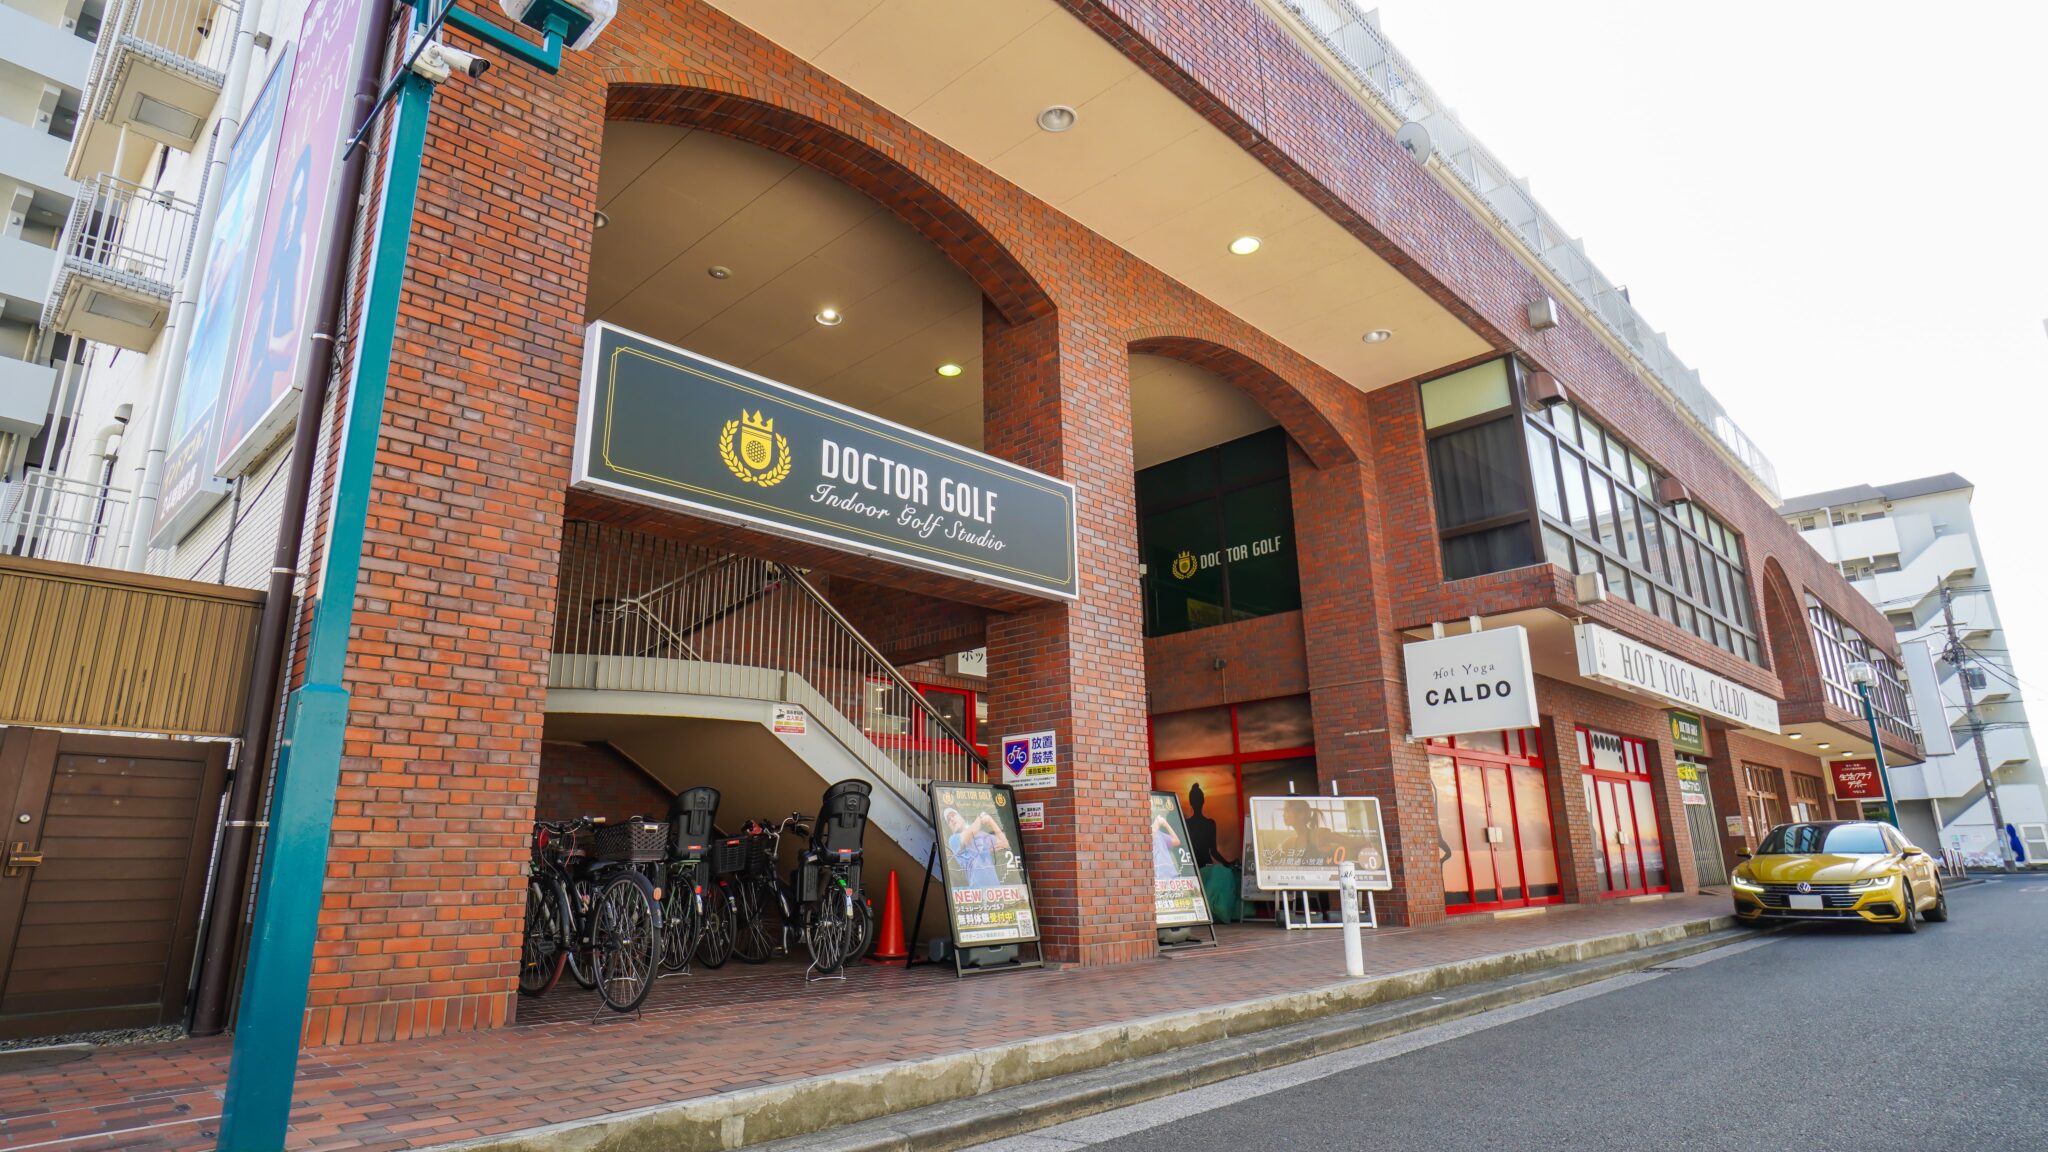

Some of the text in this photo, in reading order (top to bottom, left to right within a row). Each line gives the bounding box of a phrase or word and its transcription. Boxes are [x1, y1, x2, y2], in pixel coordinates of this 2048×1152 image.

[821, 439, 998, 524] DOCTOR GOLF
[810, 483, 1007, 552] Indoor Golf Studio
[1252, 535, 1282, 557] GOLF
[1433, 663, 1496, 680] Hot Yoga
[1619, 643, 1656, 689] HOT
[1658, 659, 1700, 704] YOGA
[1710, 678, 1748, 721] CALDO
[1425, 680, 1512, 706] CALDO
[1031, 735, 1053, 750] 放置
[1031, 750, 1054, 764] 厳禁
[1839, 771, 1872, 781] 生活クラブ
[1847, 780, 1868, 788] デポー
[1005, 850, 1022, 869] 2F
[1178, 848, 1192, 863] 2F
[1169, 879, 1194, 890] OPEN
[954, 888, 1020, 903] NEW OPEN
